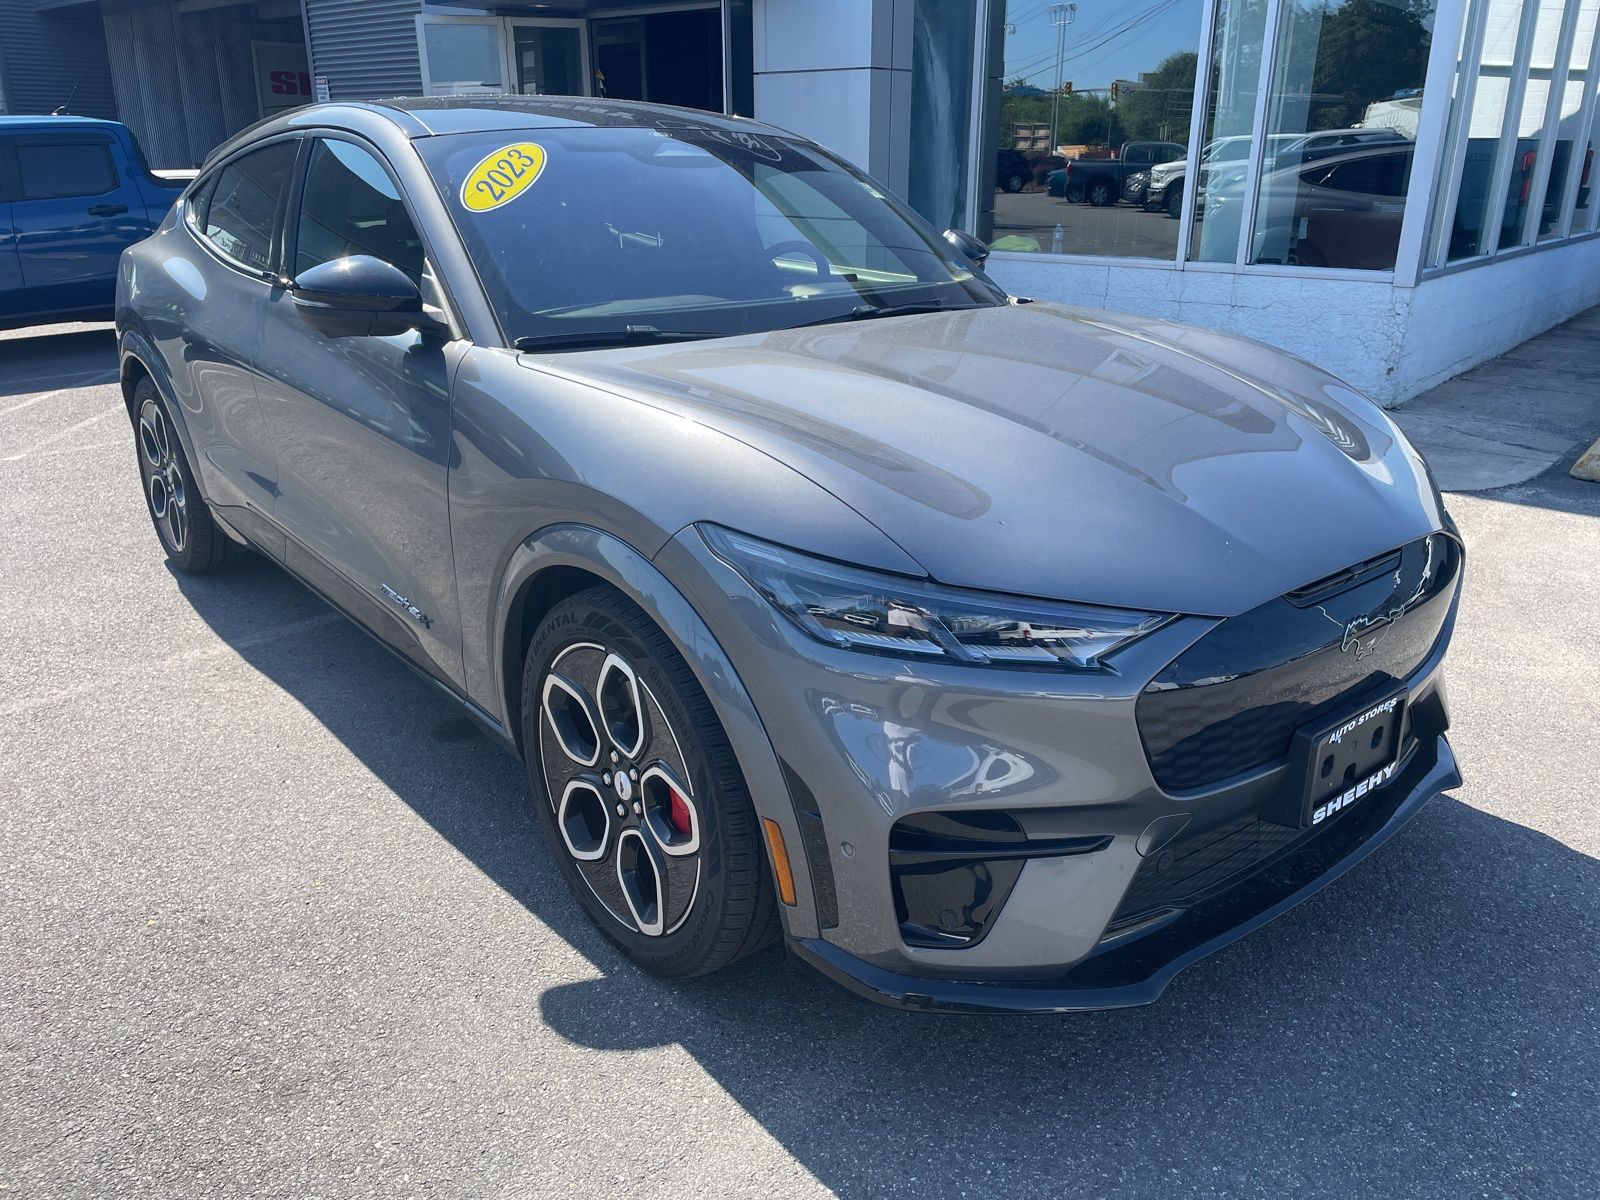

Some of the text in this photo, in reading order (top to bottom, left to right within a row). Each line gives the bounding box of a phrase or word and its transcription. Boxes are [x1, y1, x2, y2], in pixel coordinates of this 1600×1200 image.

[476, 149, 534, 201] 2023
[1328, 697, 1398, 744] AUTO STORES
[1312, 761, 1397, 825] SHEEHY
